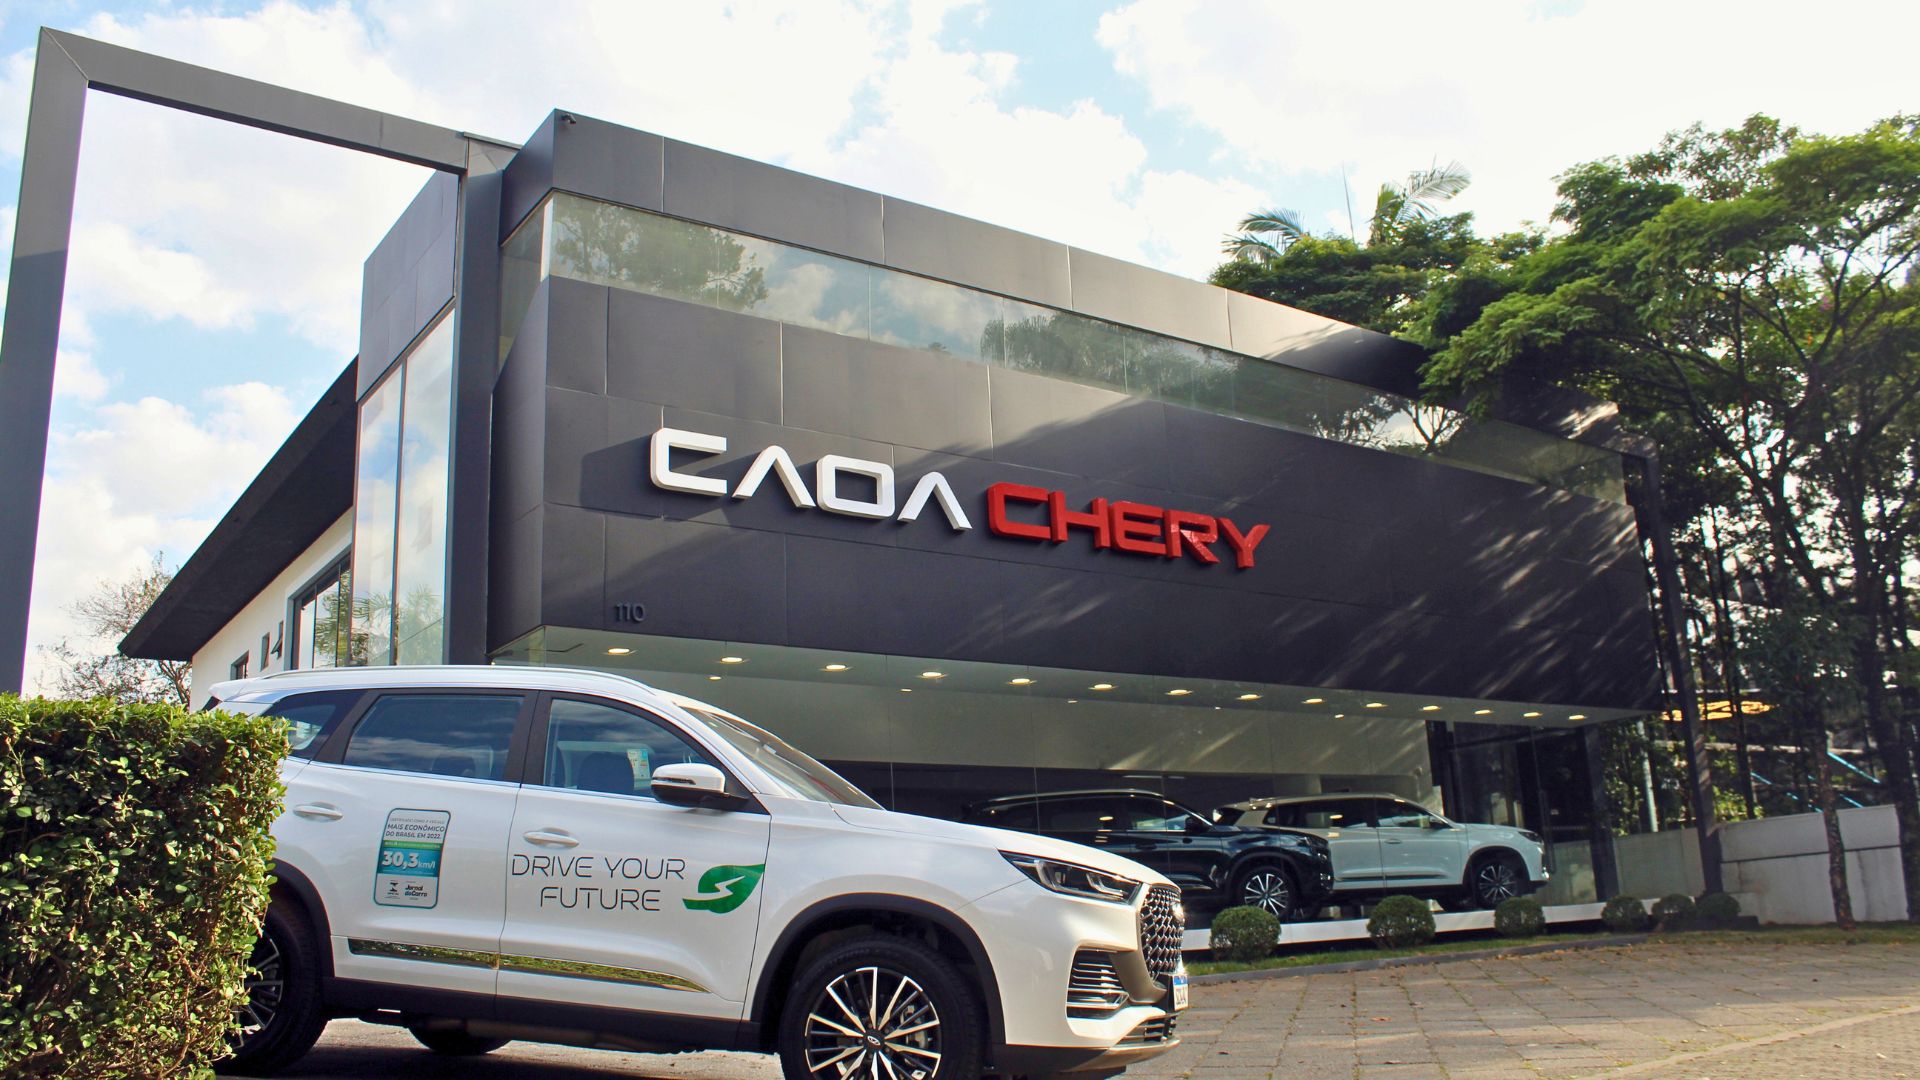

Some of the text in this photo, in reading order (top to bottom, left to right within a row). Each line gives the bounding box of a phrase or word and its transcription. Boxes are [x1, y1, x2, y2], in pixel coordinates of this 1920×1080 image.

[650, 427, 1271, 569] CAOA CHERY
[615, 602, 645, 622] 110
[404, 824, 445, 832] ECONÔMICO
[511, 854, 686, 880] DRIVE YOUR
[540, 886, 661, 911] FUTURE
